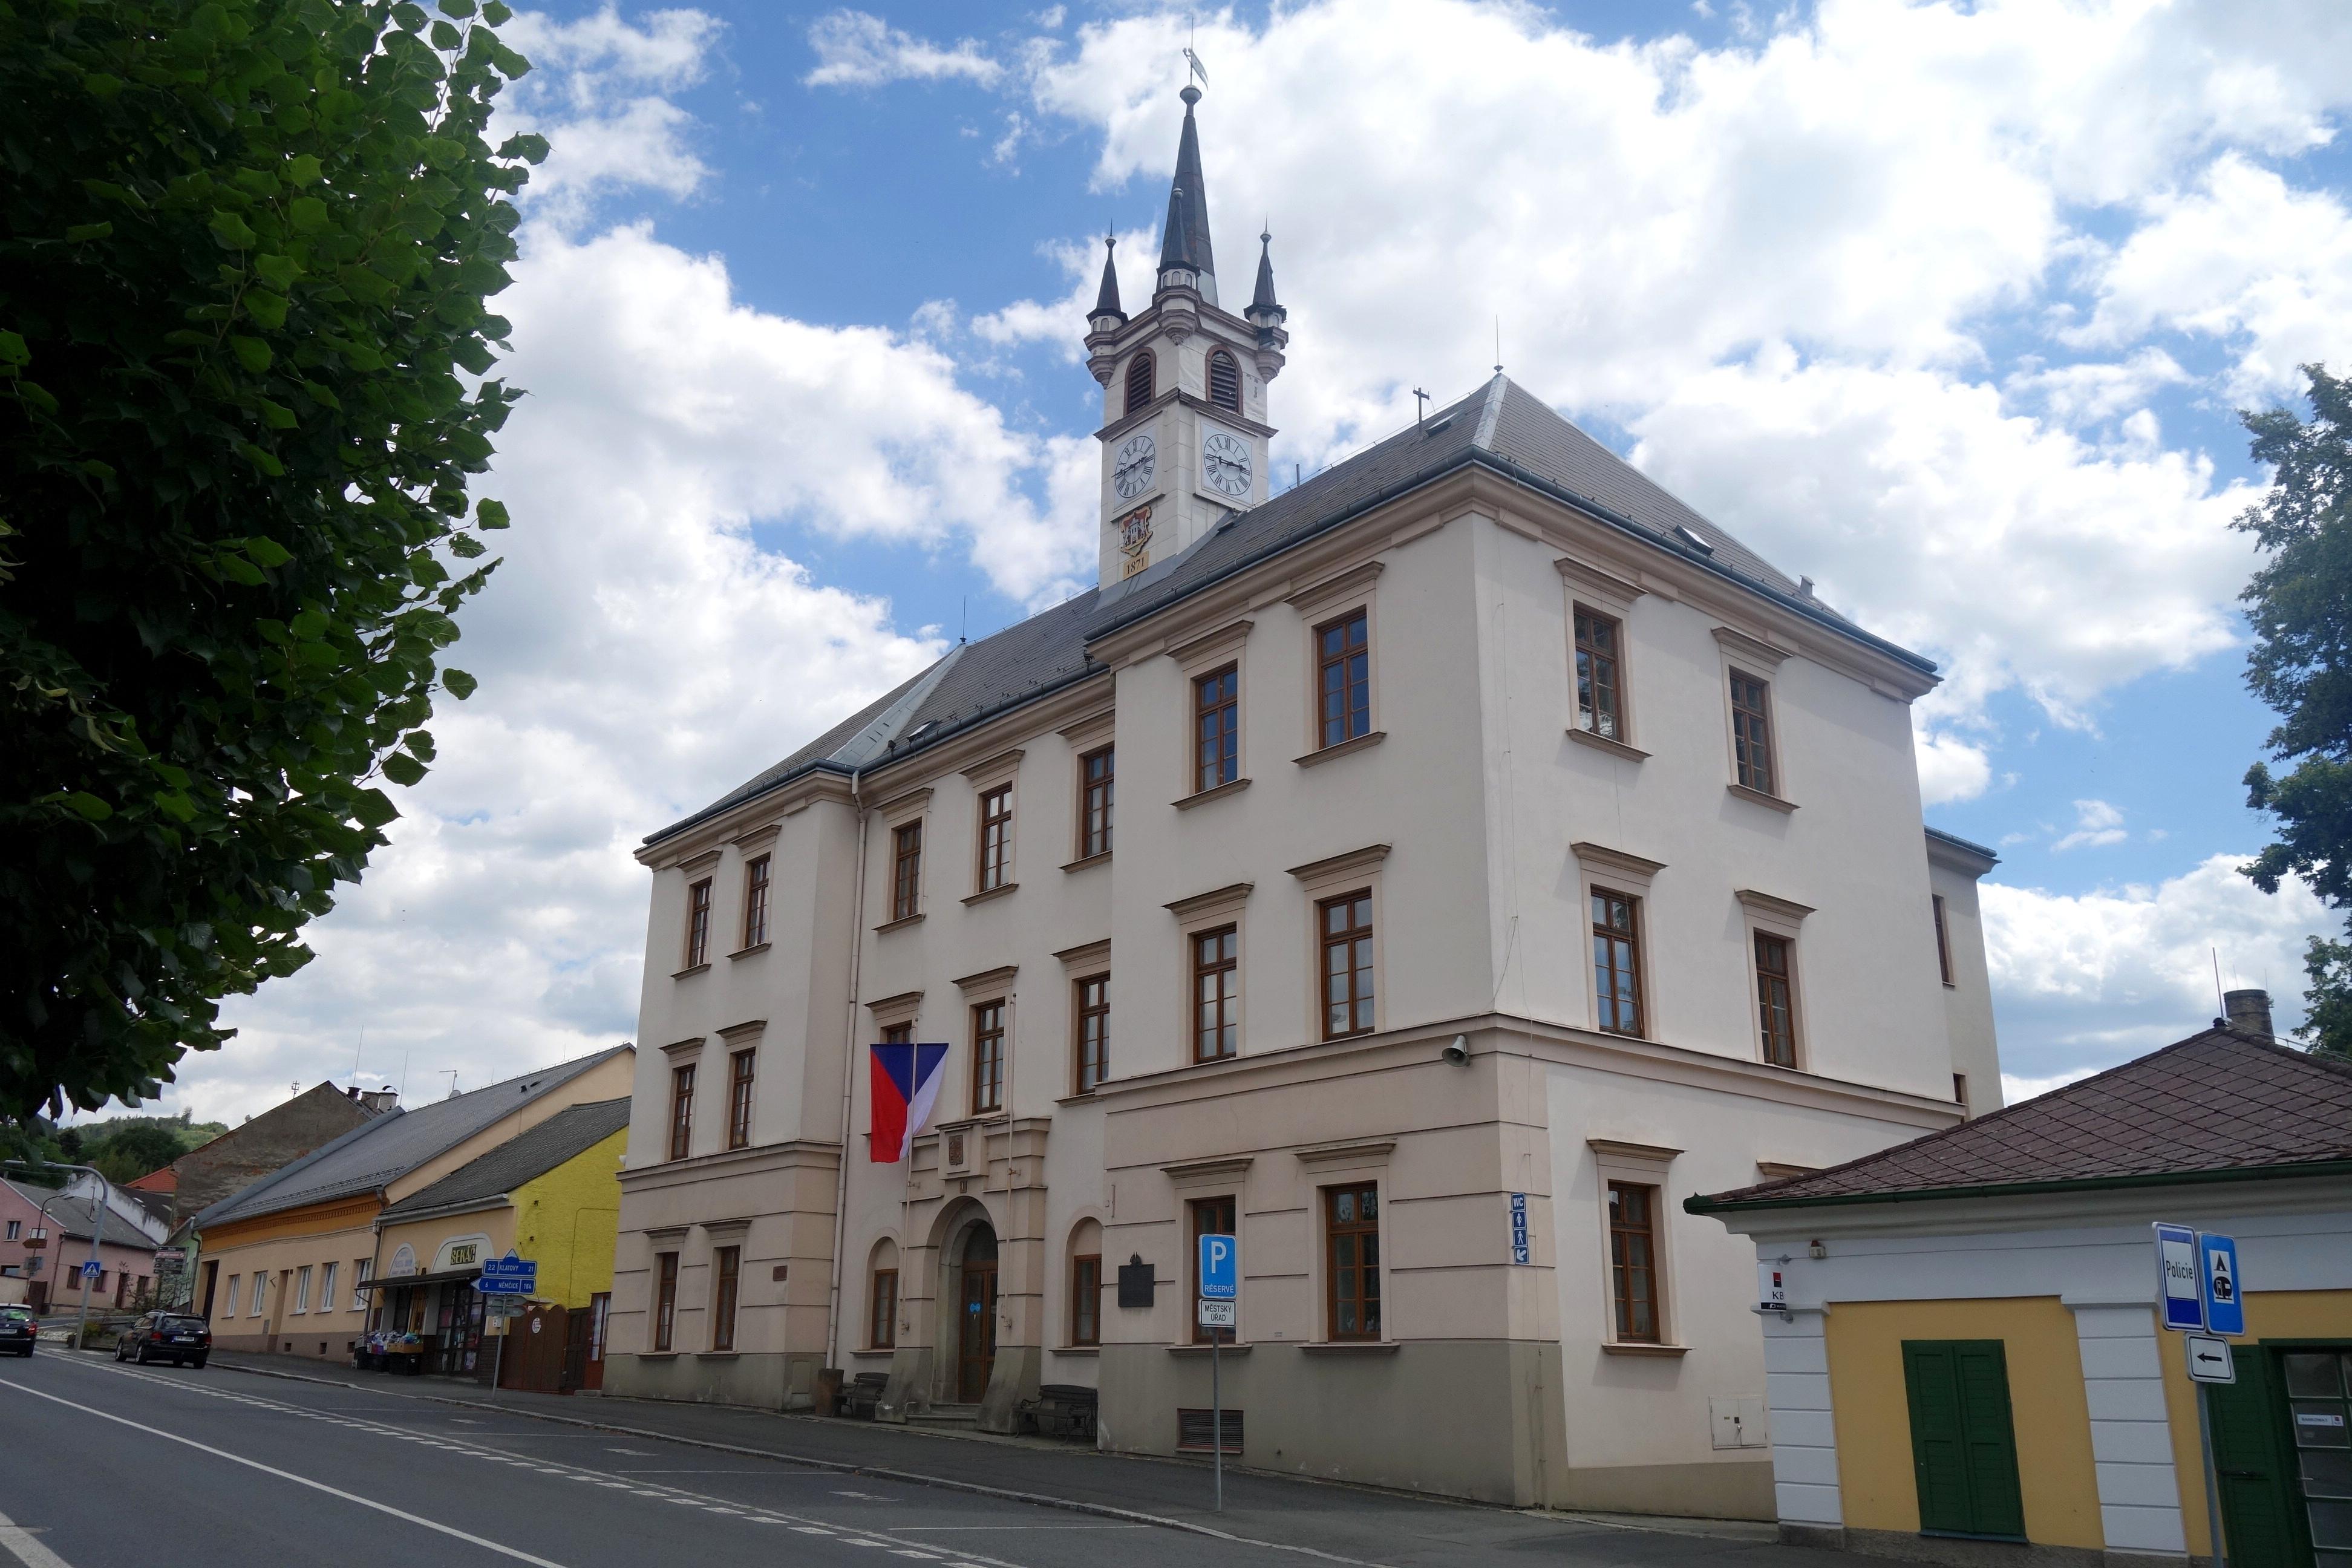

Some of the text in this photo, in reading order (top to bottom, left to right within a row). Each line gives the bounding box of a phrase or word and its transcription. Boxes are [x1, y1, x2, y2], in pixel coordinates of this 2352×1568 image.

[1145, 443, 1152, 455] II
[1235, 482, 1241, 493] V
[1127, 556, 1145, 575] 1871
[1513, 1197, 1524, 1207] WC
[451, 1244, 475, 1264] SEKÁČ
[1211, 1241, 1227, 1274] P
[2166, 1259, 2194, 1279] Policie
[498, 1281, 519, 1289] NĚMČICE
[1204, 1283, 1235, 1294] RÉSERVÉ
[1772, 1291, 1784, 1300] KB
[1204, 1303, 1232, 1313] MĚSTSKÝ
[1210, 1312, 1227, 1322] ÚŘAD
